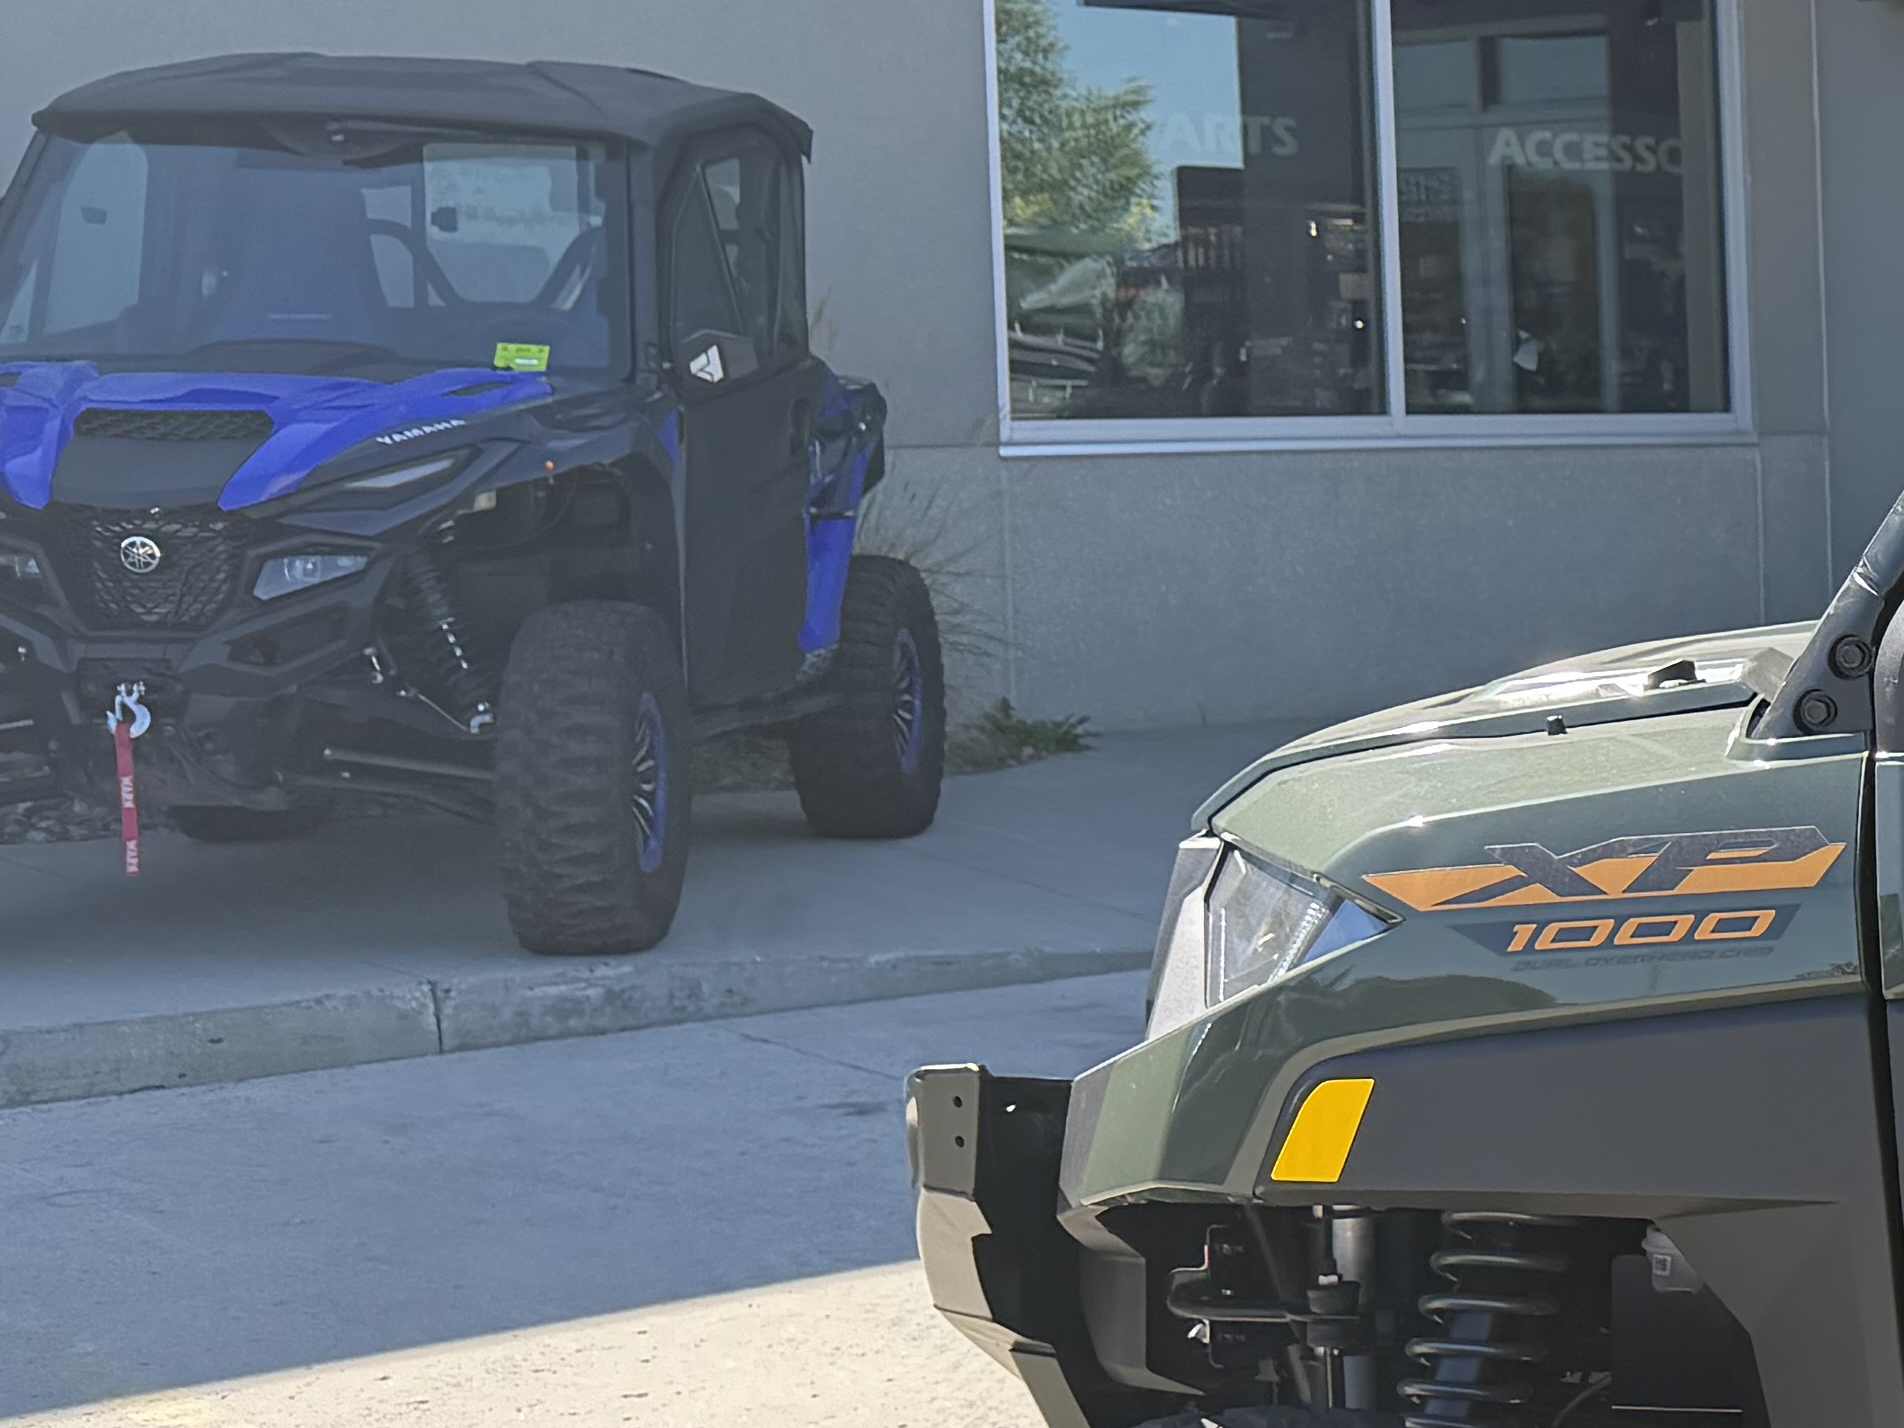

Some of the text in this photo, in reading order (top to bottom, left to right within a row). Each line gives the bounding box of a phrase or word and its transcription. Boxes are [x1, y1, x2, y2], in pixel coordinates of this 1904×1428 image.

[1156, 111, 1300, 157] ARTS
[376, 419, 466, 445] YAMAHA
[1430, 826, 1834, 907] XP
[1506, 909, 1777, 953] 1000
